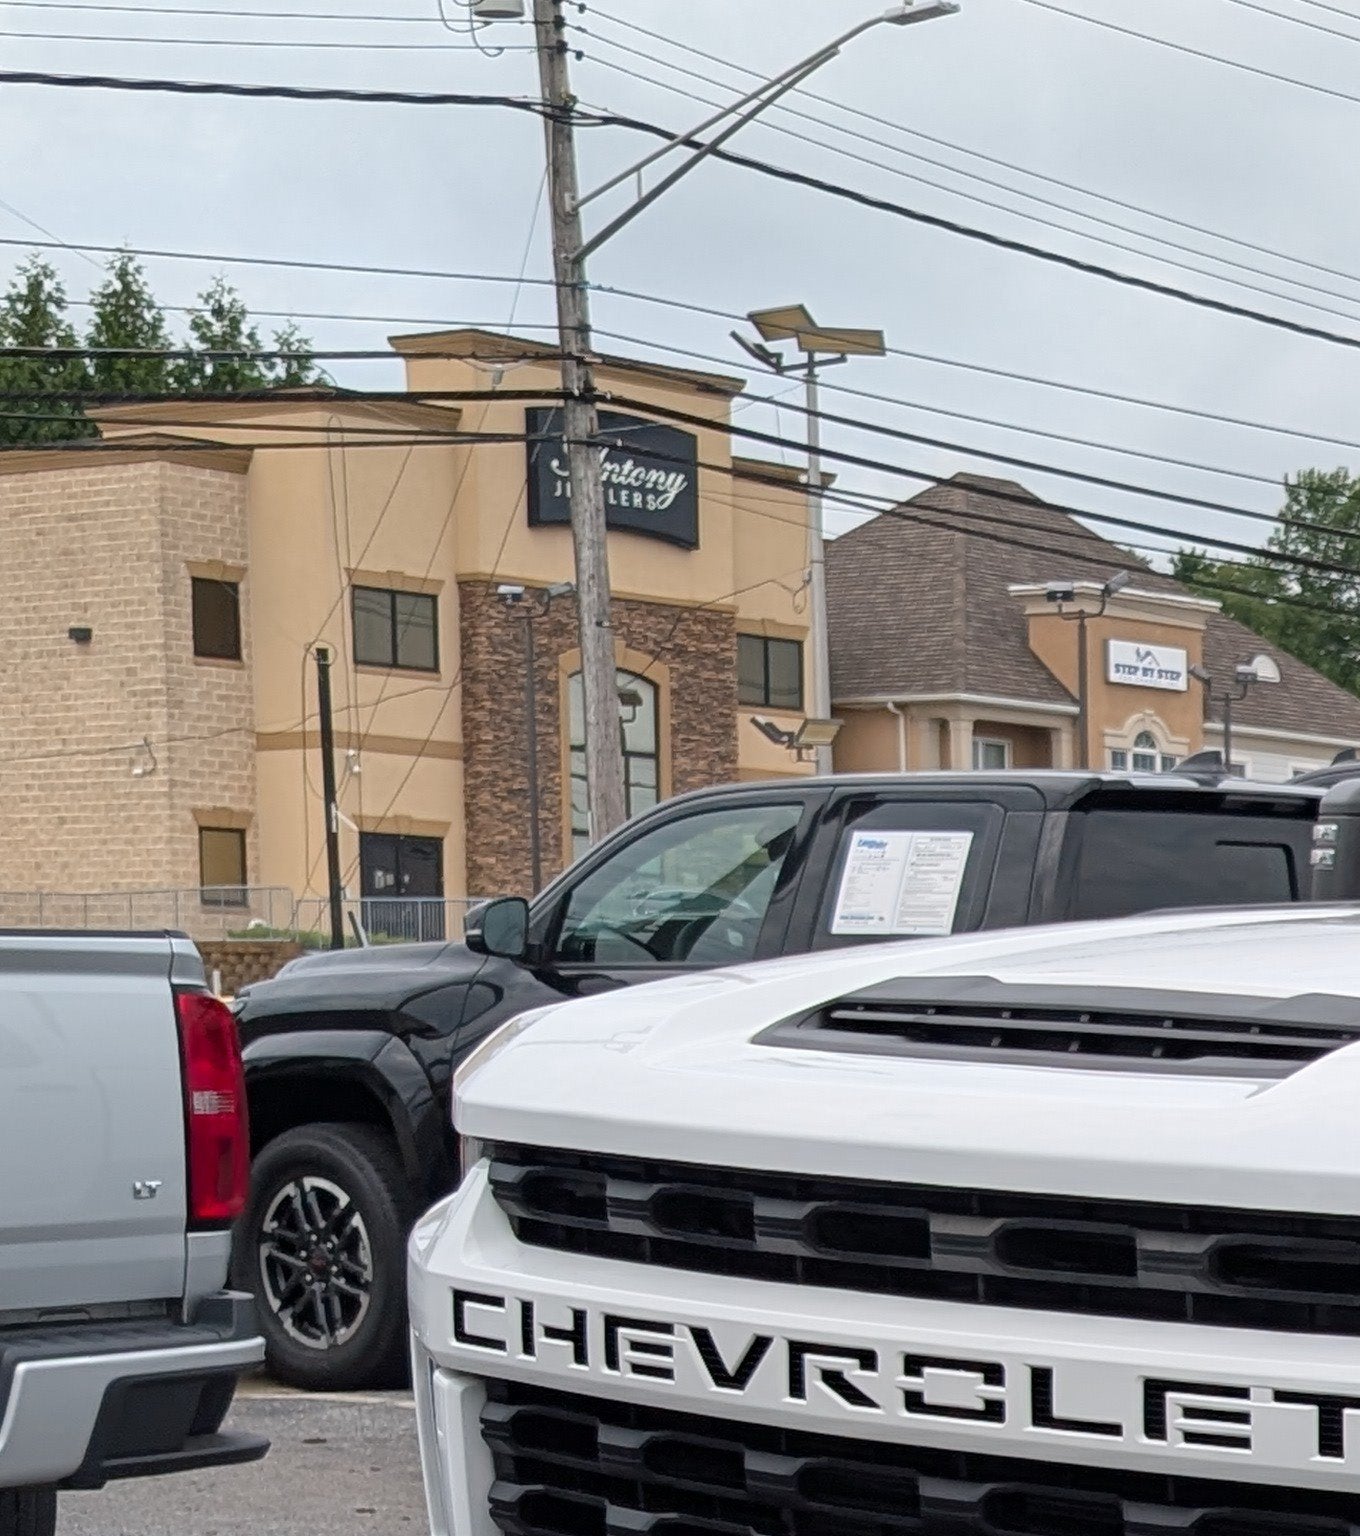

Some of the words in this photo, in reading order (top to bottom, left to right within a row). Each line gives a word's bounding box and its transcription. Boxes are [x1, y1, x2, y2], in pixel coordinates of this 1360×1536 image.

[1114, 663, 1139, 675] STEP
[1142, 667, 1155, 677] BY
[1157, 669, 1181, 681] STEP
